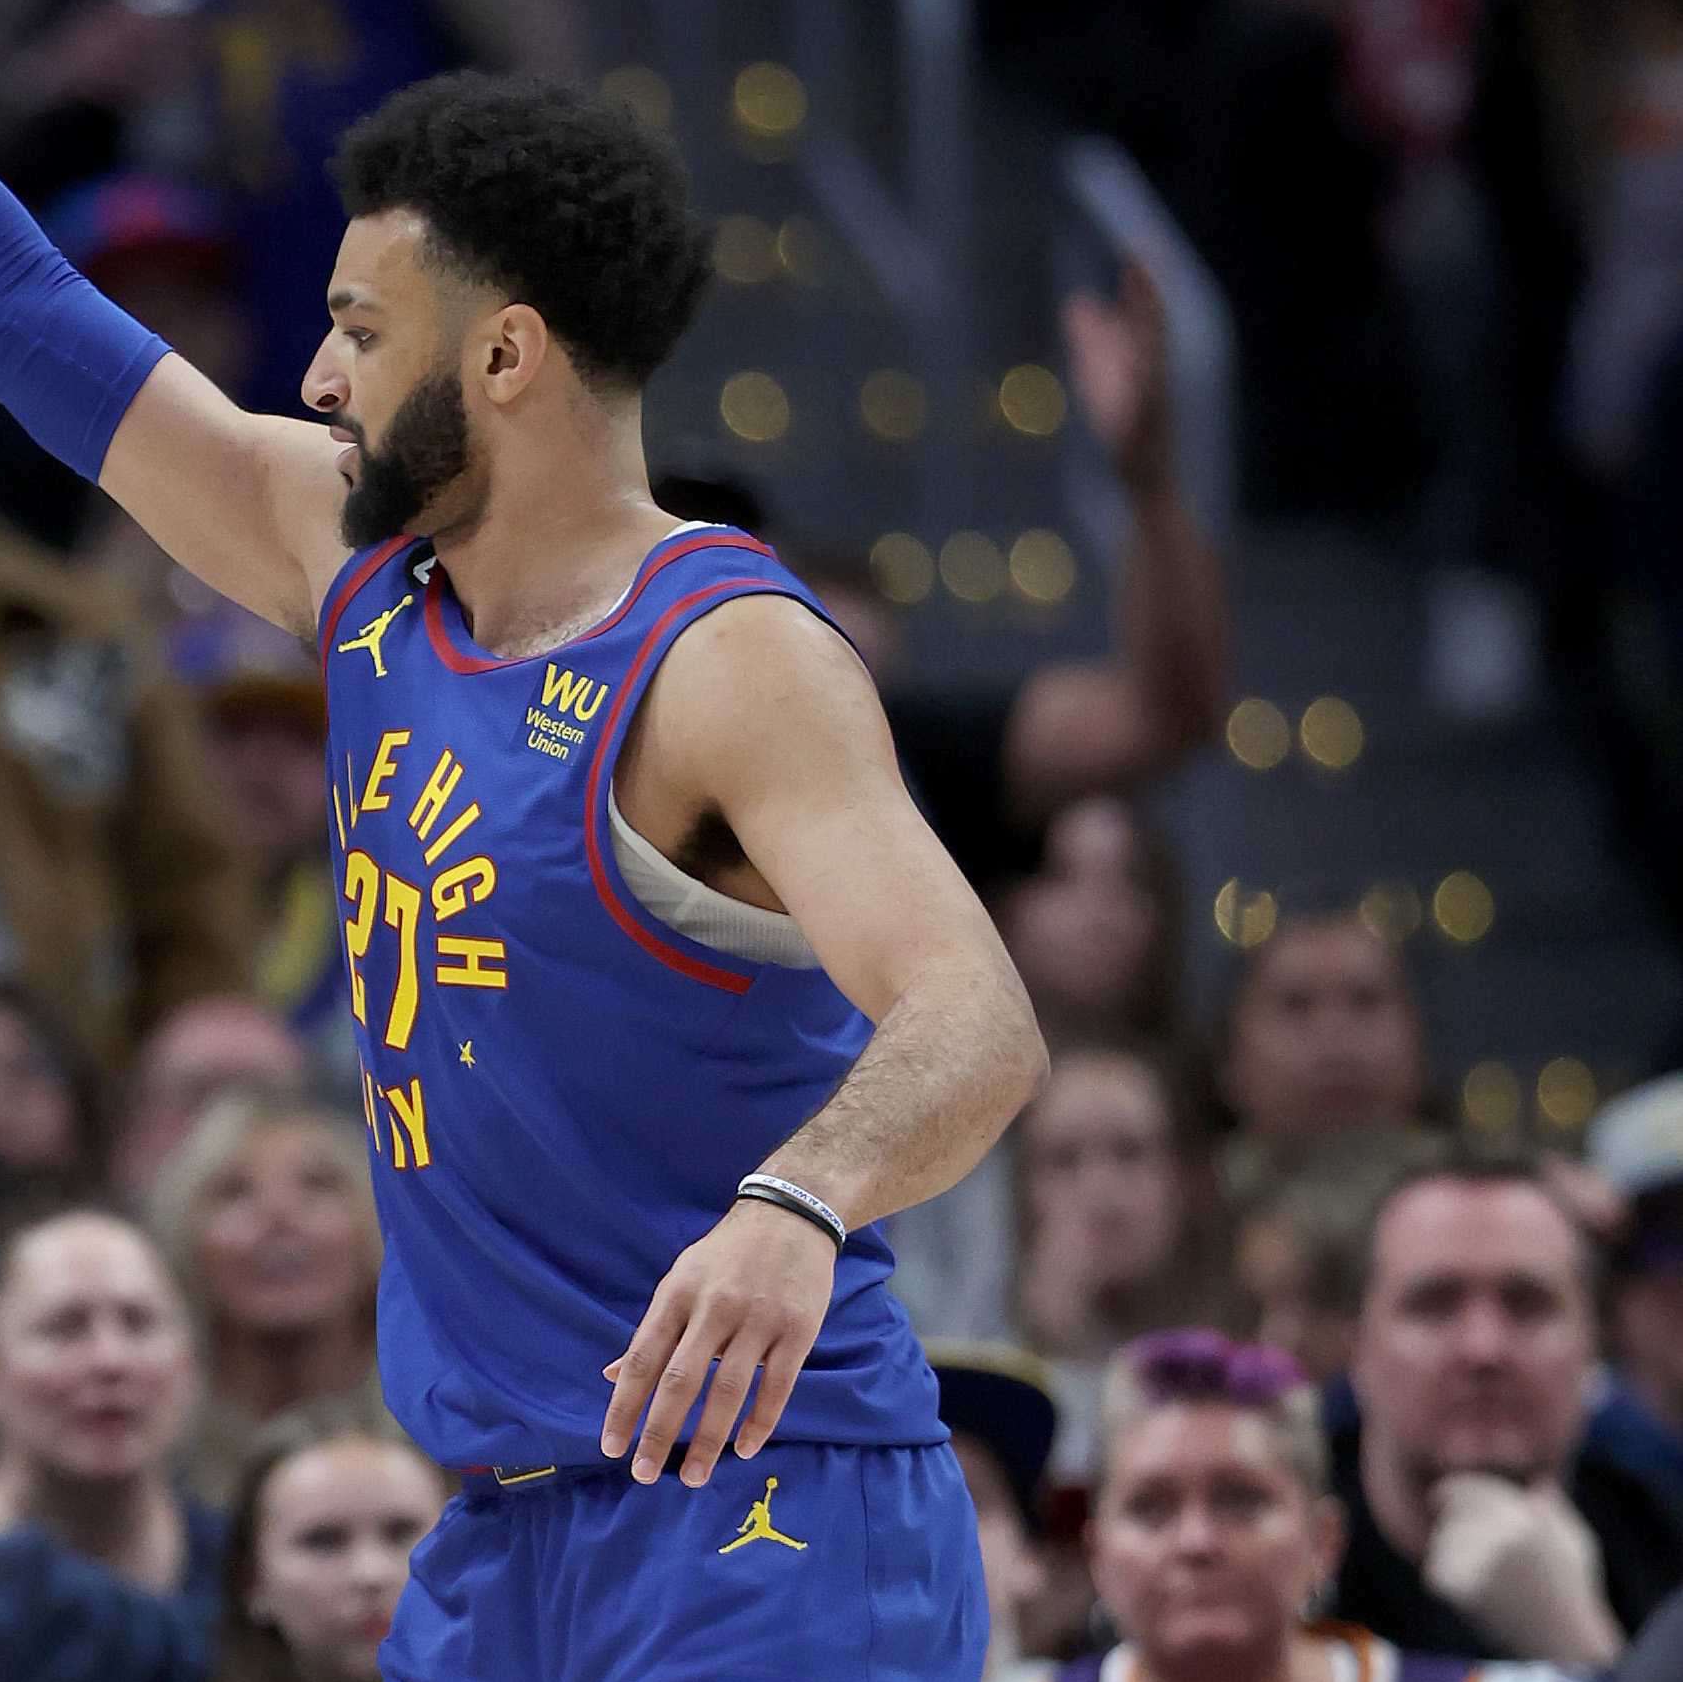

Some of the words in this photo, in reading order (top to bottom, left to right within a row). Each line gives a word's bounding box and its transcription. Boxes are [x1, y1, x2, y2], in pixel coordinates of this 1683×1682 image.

[540, 662, 609, 721] WU
[526, 706, 585, 744] Western
[527, 729, 570, 760] Union
[408, 747, 509, 989] HIGH
[344, 847, 421, 1051] 27
